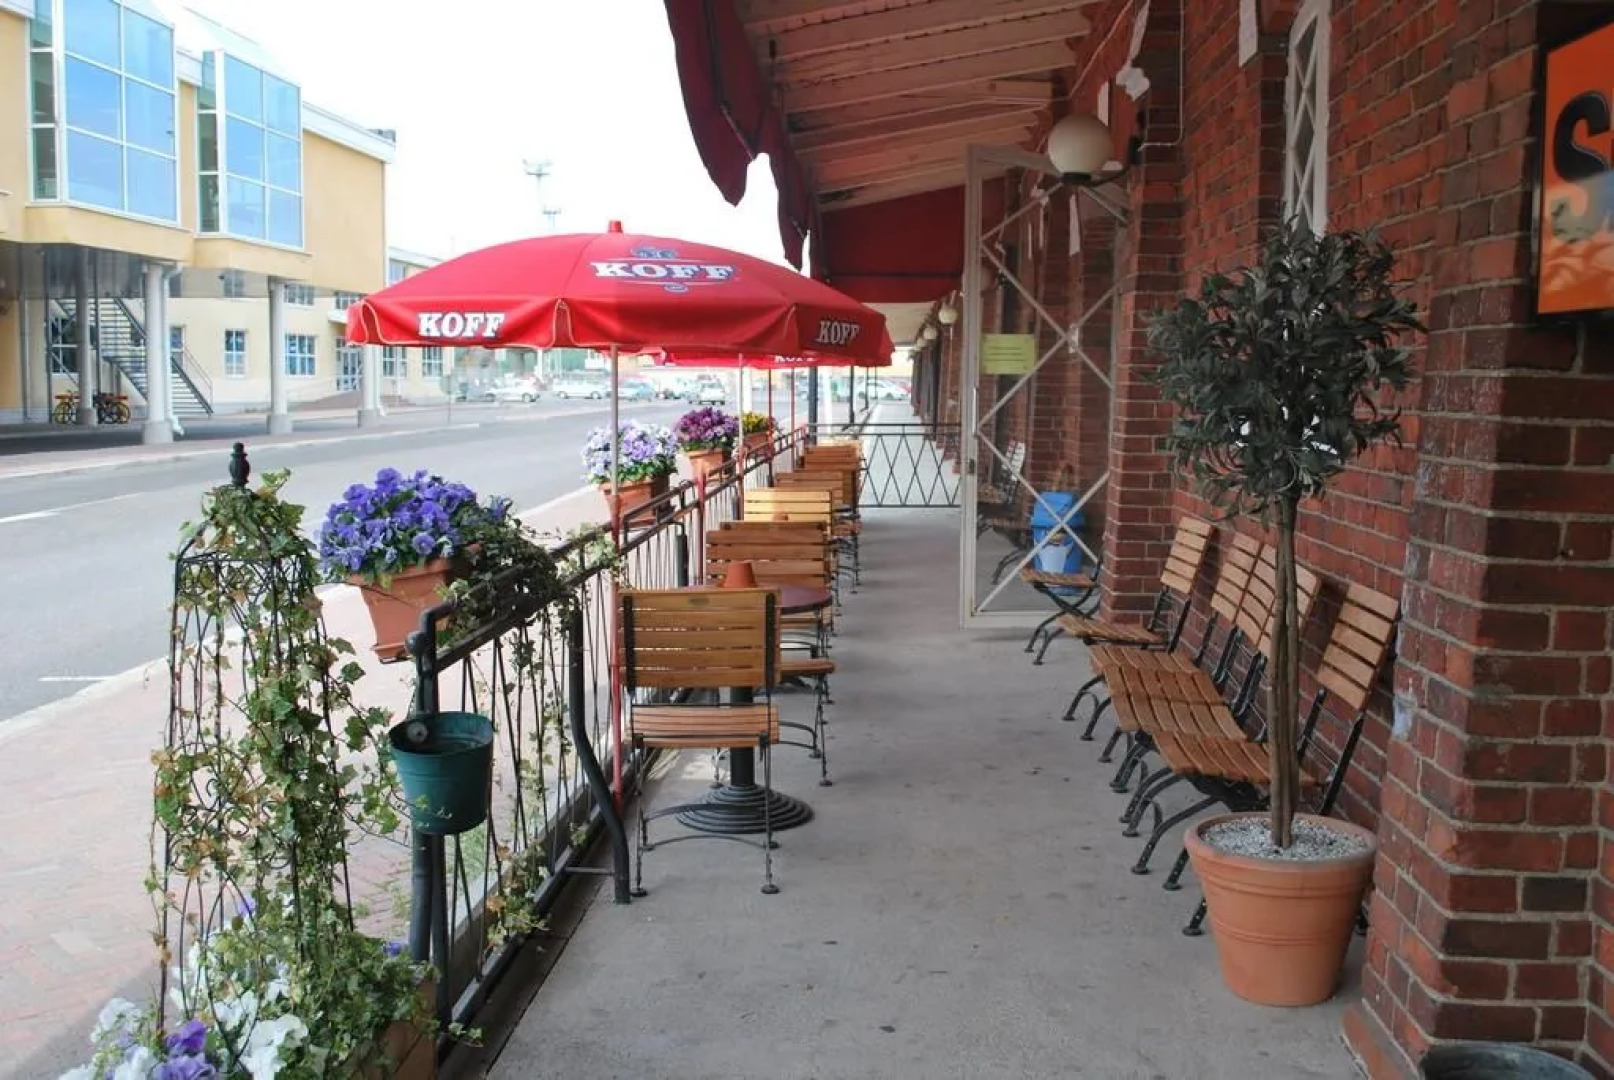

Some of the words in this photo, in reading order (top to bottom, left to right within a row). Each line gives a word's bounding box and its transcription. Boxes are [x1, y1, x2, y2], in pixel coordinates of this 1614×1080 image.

[1553, 89, 1614, 243] S
[590, 261, 734, 280] KOFF
[418, 312, 505, 338] KOFF
[814, 320, 860, 345] KOFF
